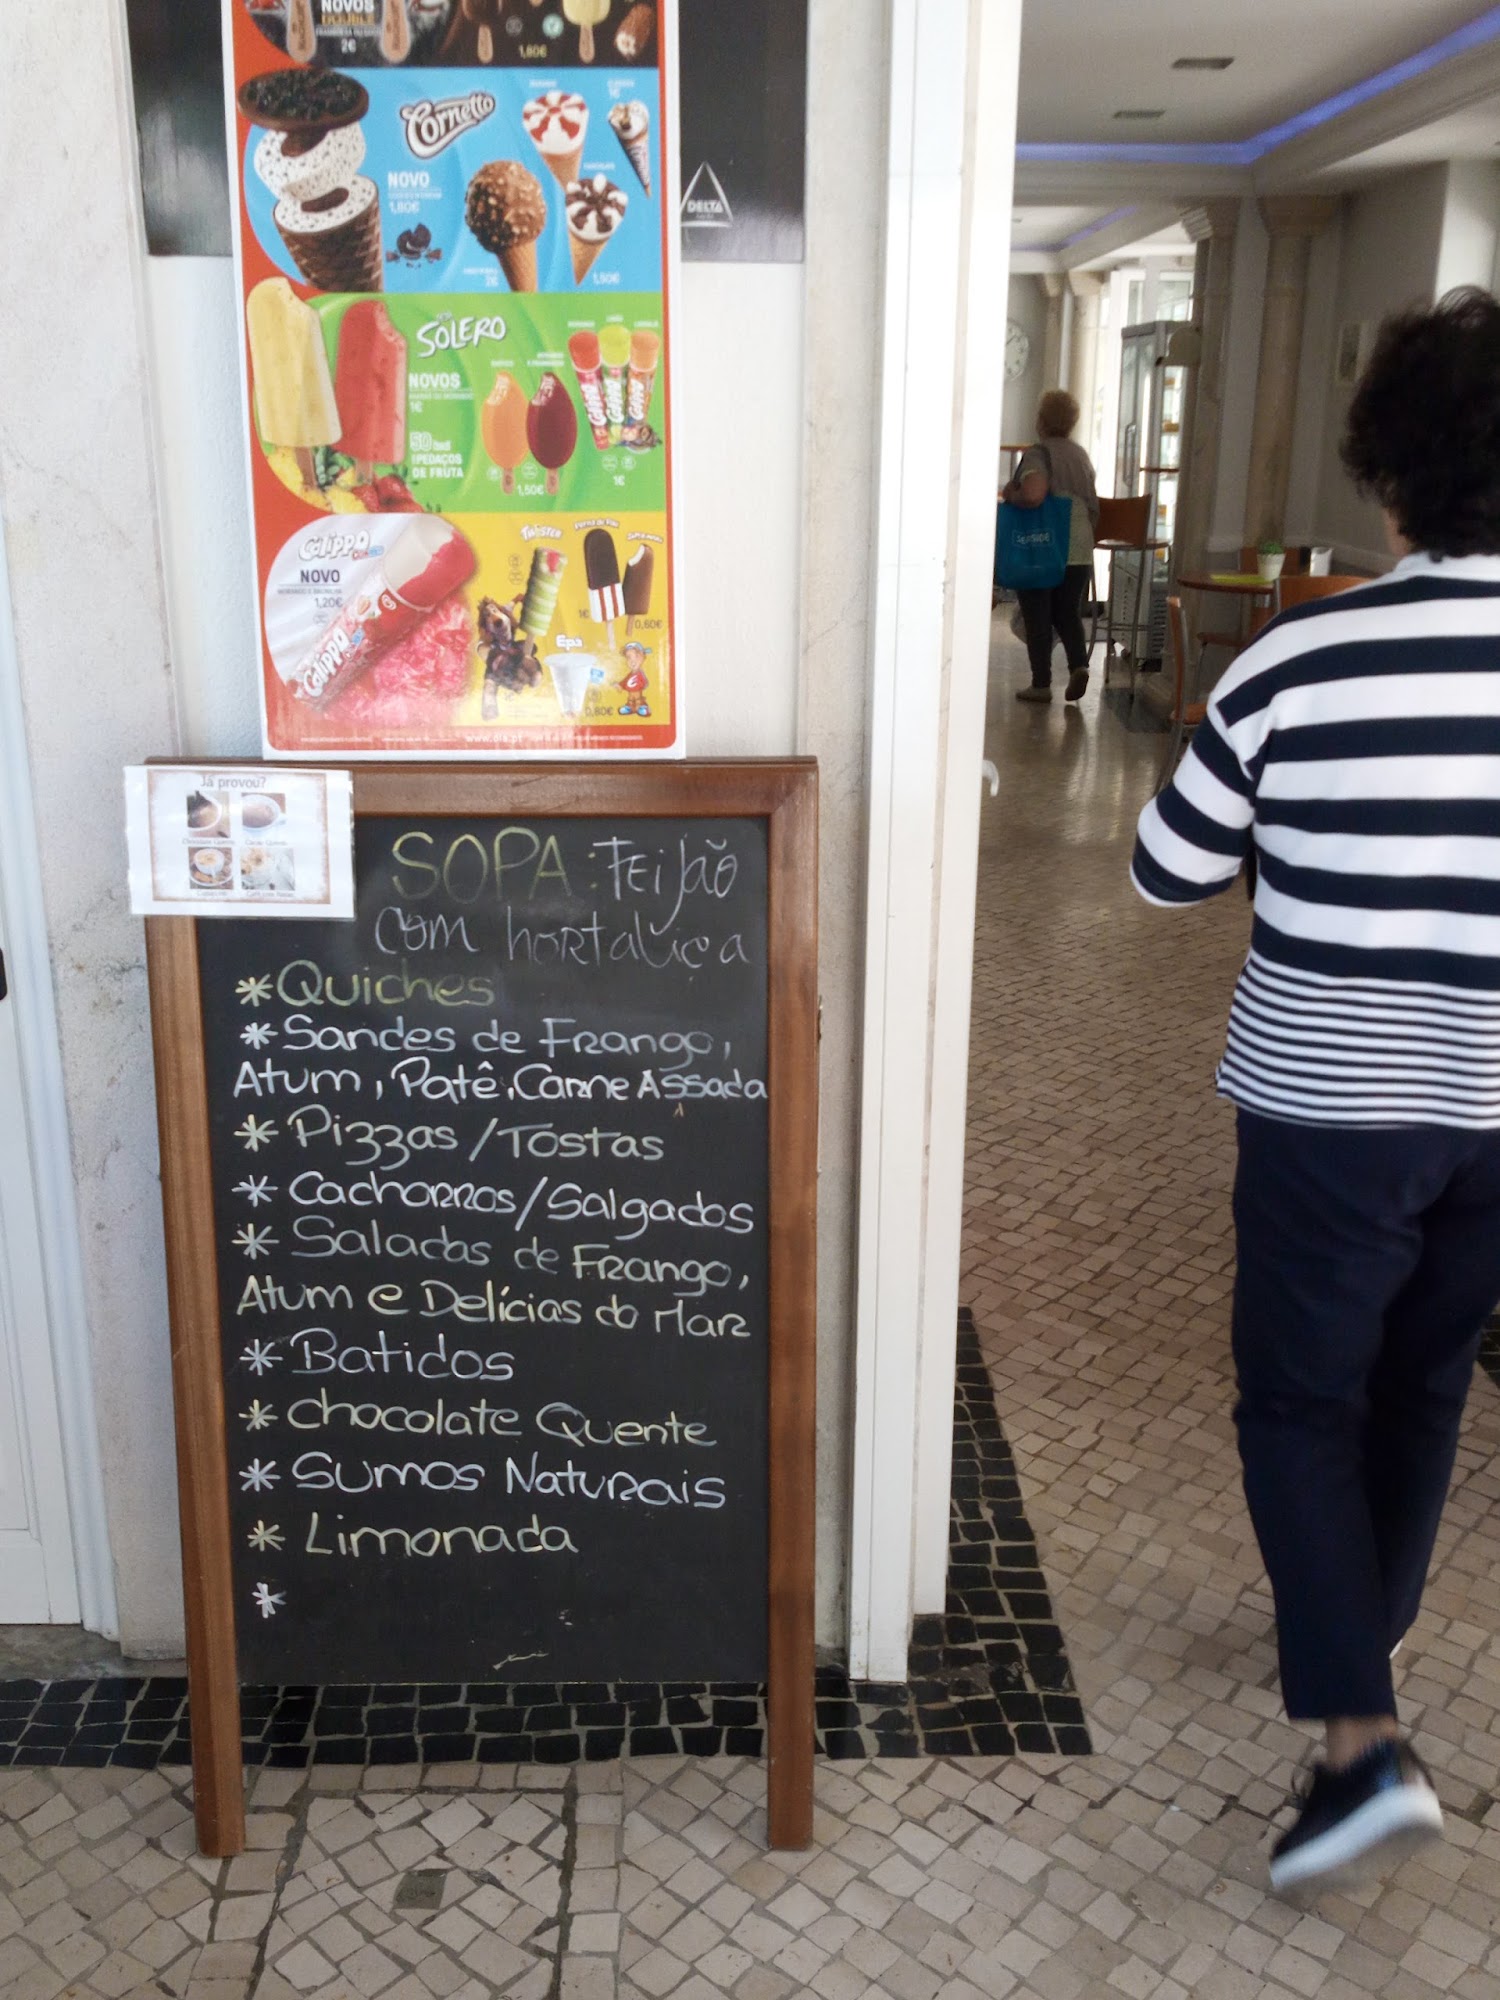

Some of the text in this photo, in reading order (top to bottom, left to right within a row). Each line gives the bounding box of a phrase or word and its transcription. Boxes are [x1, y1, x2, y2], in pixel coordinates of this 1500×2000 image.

[321, 0, 375, 13] NOVOS
[400, 92, 495, 159] Cornetto
[387, 171, 430, 188] NOVO
[687, 200, 724, 213] DELTA
[416, 315, 506, 358] SOLERO
[408, 373, 461, 388] NOVOS
[412, 467, 463, 478] DE FRUTA
[298, 530, 370, 562] Calippo
[300, 569, 340, 583] NOVO
[315, 597, 343, 609] 1,20€
[303, 627, 350, 697] Calippo
[200, 775, 266, 790] Já provou?
[277, 958, 495, 1007] Quiches
[283, 1014, 456, 1052] Sandes
[472, 1016, 525, 1053] de
[513, 1063, 629, 1100] Carne
[637, 1068, 768, 1100] Assada
[287, 1104, 459, 1170] Pizzas
[291, 1215, 492, 1265] Saladas
[514, 1236, 559, 1274] de
[237, 1275, 751, 1337] Atum e Delícias do Mar
[290, 1327, 515, 1380] Batidos
[287, 1387, 717, 1447] Chocolate Quente
[291, 1451, 726, 1509] Sumos Naturais
[305, 1512, 579, 1557] Limonada
